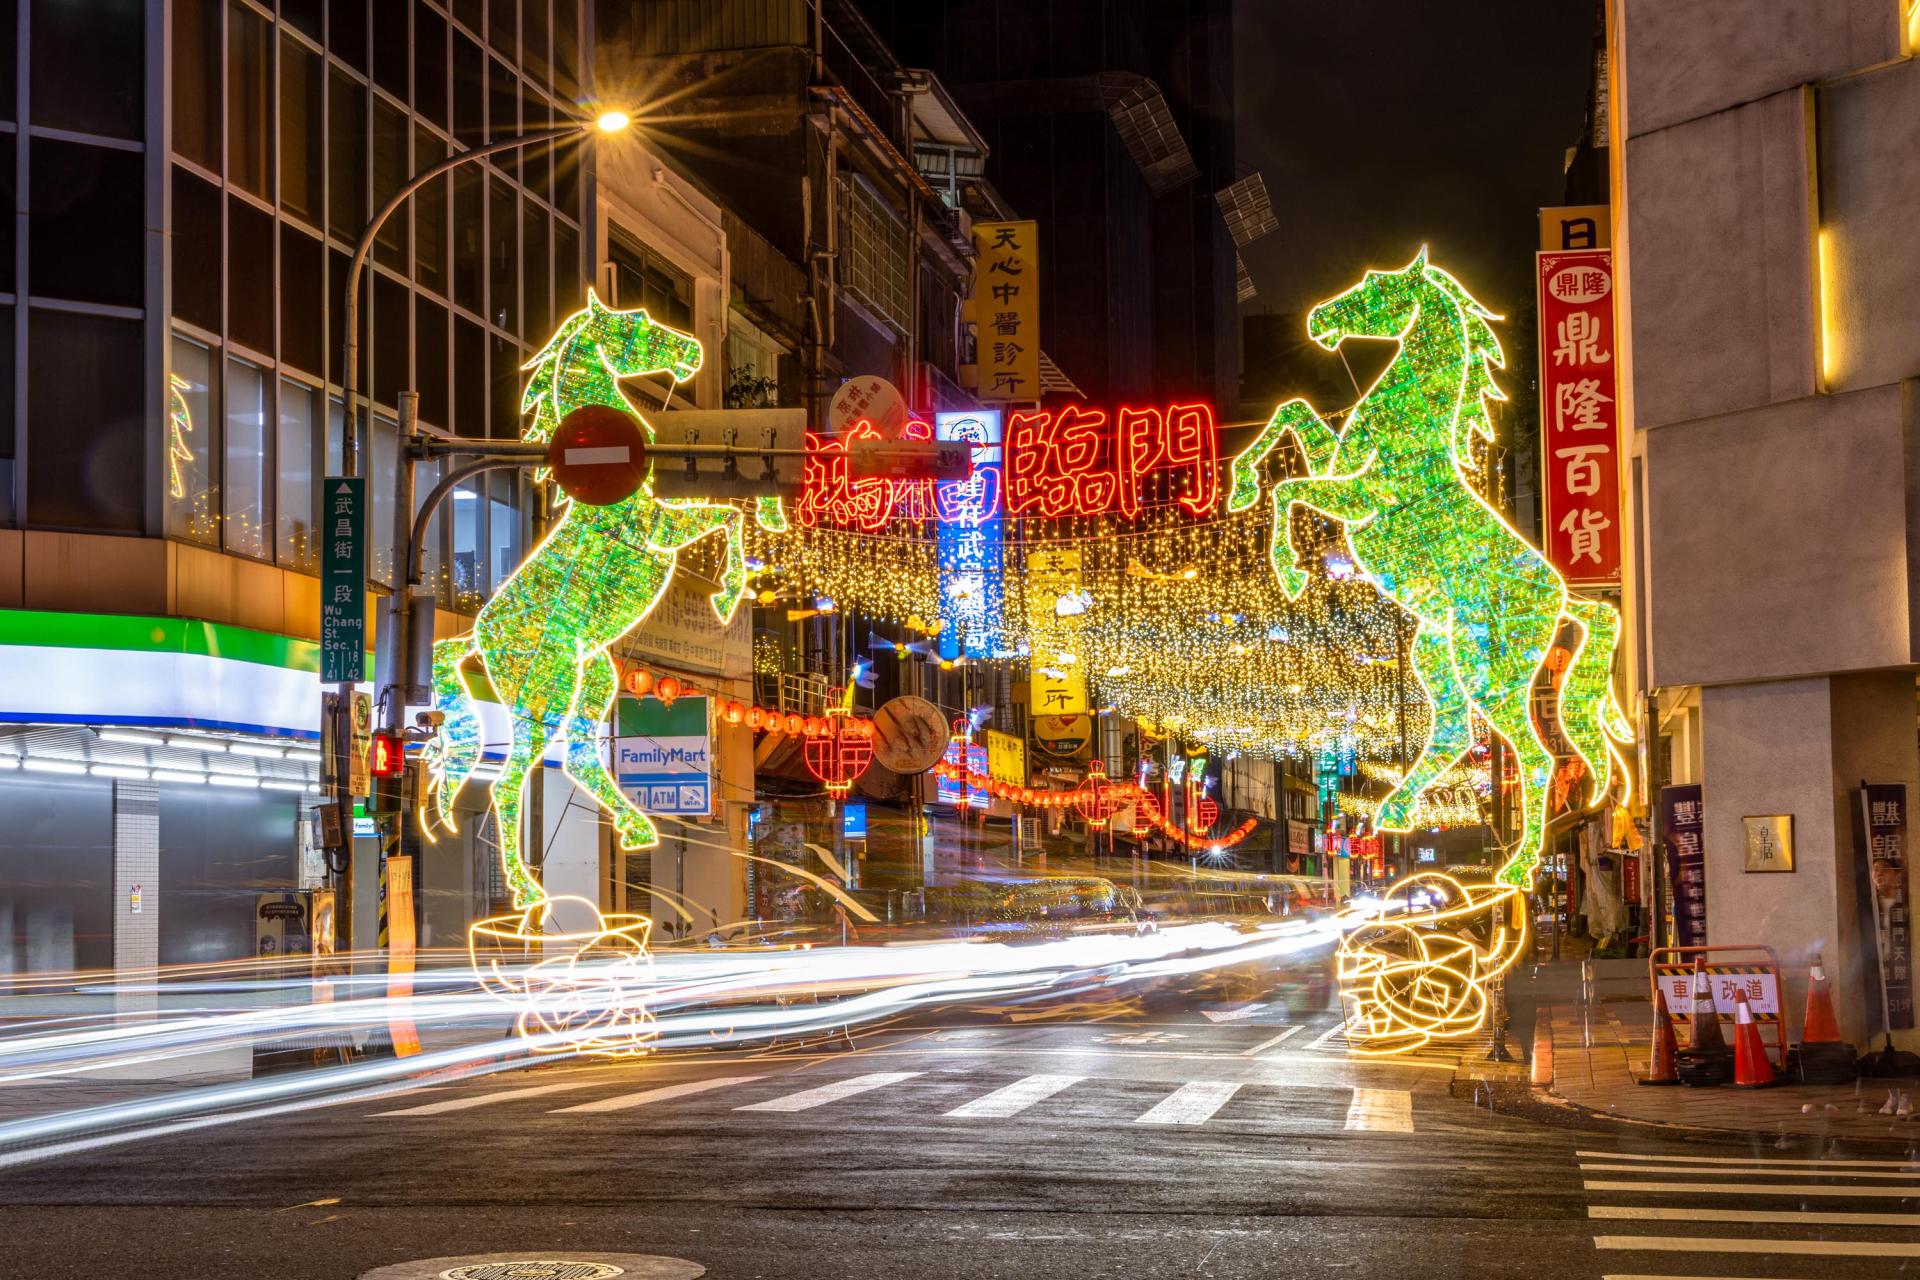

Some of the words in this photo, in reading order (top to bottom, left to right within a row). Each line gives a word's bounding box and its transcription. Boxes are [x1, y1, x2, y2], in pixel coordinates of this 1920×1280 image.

[1556, 272, 1605, 296] 鼎隆
[989, 228, 1025, 394] 天心中醫診所
[1552, 310, 1614, 566] 鼎隆百貨
[334, 497, 353, 604] 武昌街一段
[324, 605, 342, 616] Wu
[324, 616, 362, 629] Chang
[324, 628, 340, 639] St.
[324, 639, 350, 650] Sec.
[354, 640, 359, 650] 1
[621, 747, 706, 766] FamilyMart
[653, 791, 675, 805] ATM
[1672, 979, 1763, 1001] 車改道
